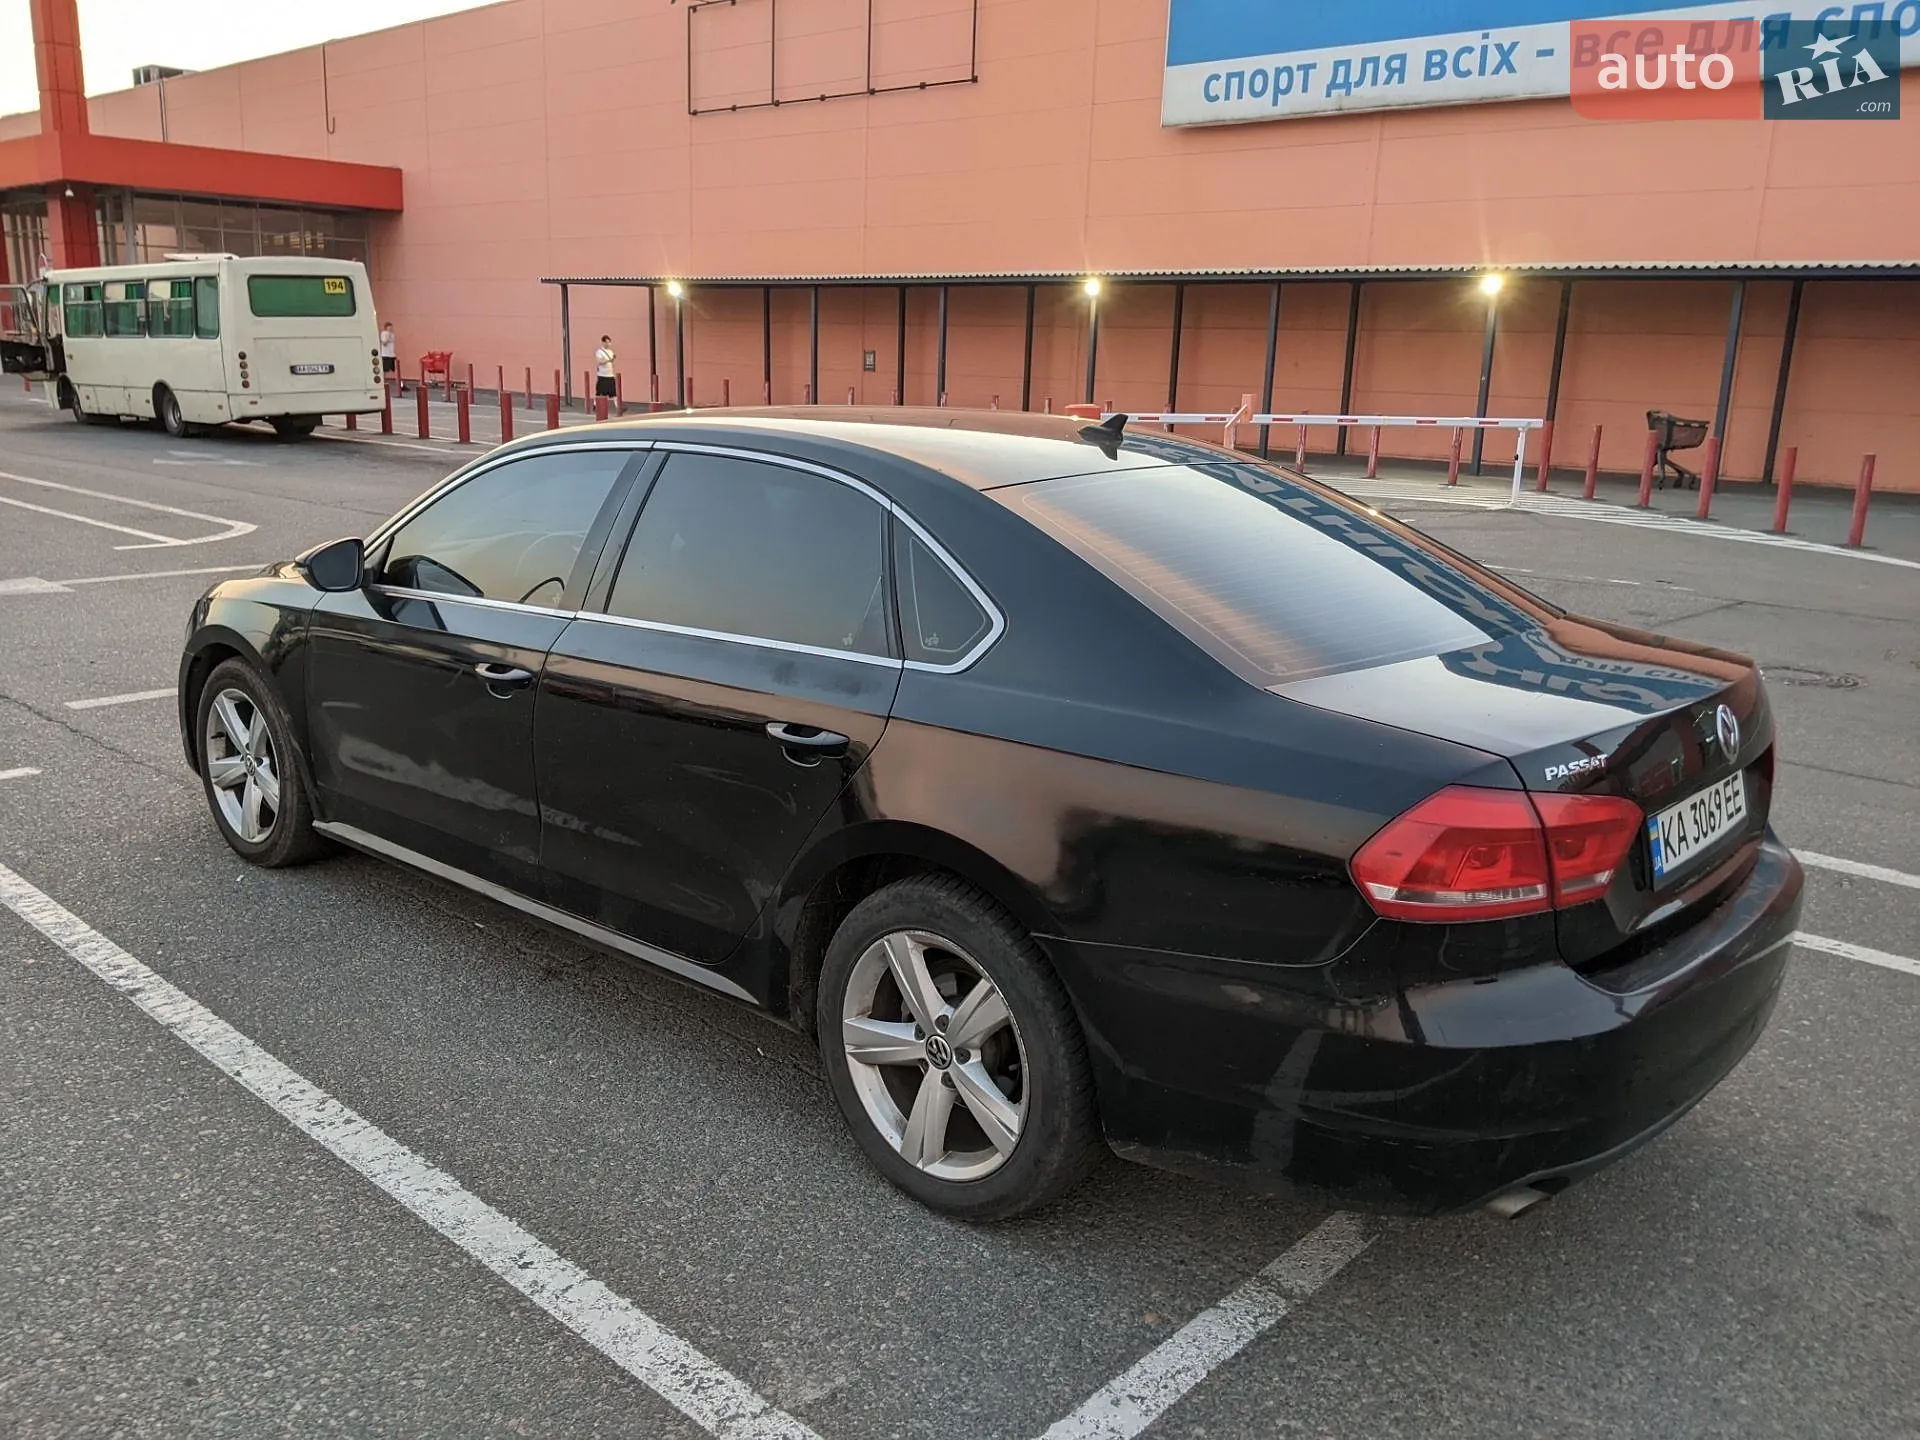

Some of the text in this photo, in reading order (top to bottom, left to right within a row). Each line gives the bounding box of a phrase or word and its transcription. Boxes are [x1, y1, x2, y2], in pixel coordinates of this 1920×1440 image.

[1203, 62, 1317, 107] спорт
[1325, 53, 1408, 98] для
[1423, 32, 1520, 82] всіх
[326, 281, 343, 291] 194
[1544, 754, 1608, 781] PASSAT
[1660, 774, 1743, 864] KA 3069 EE
